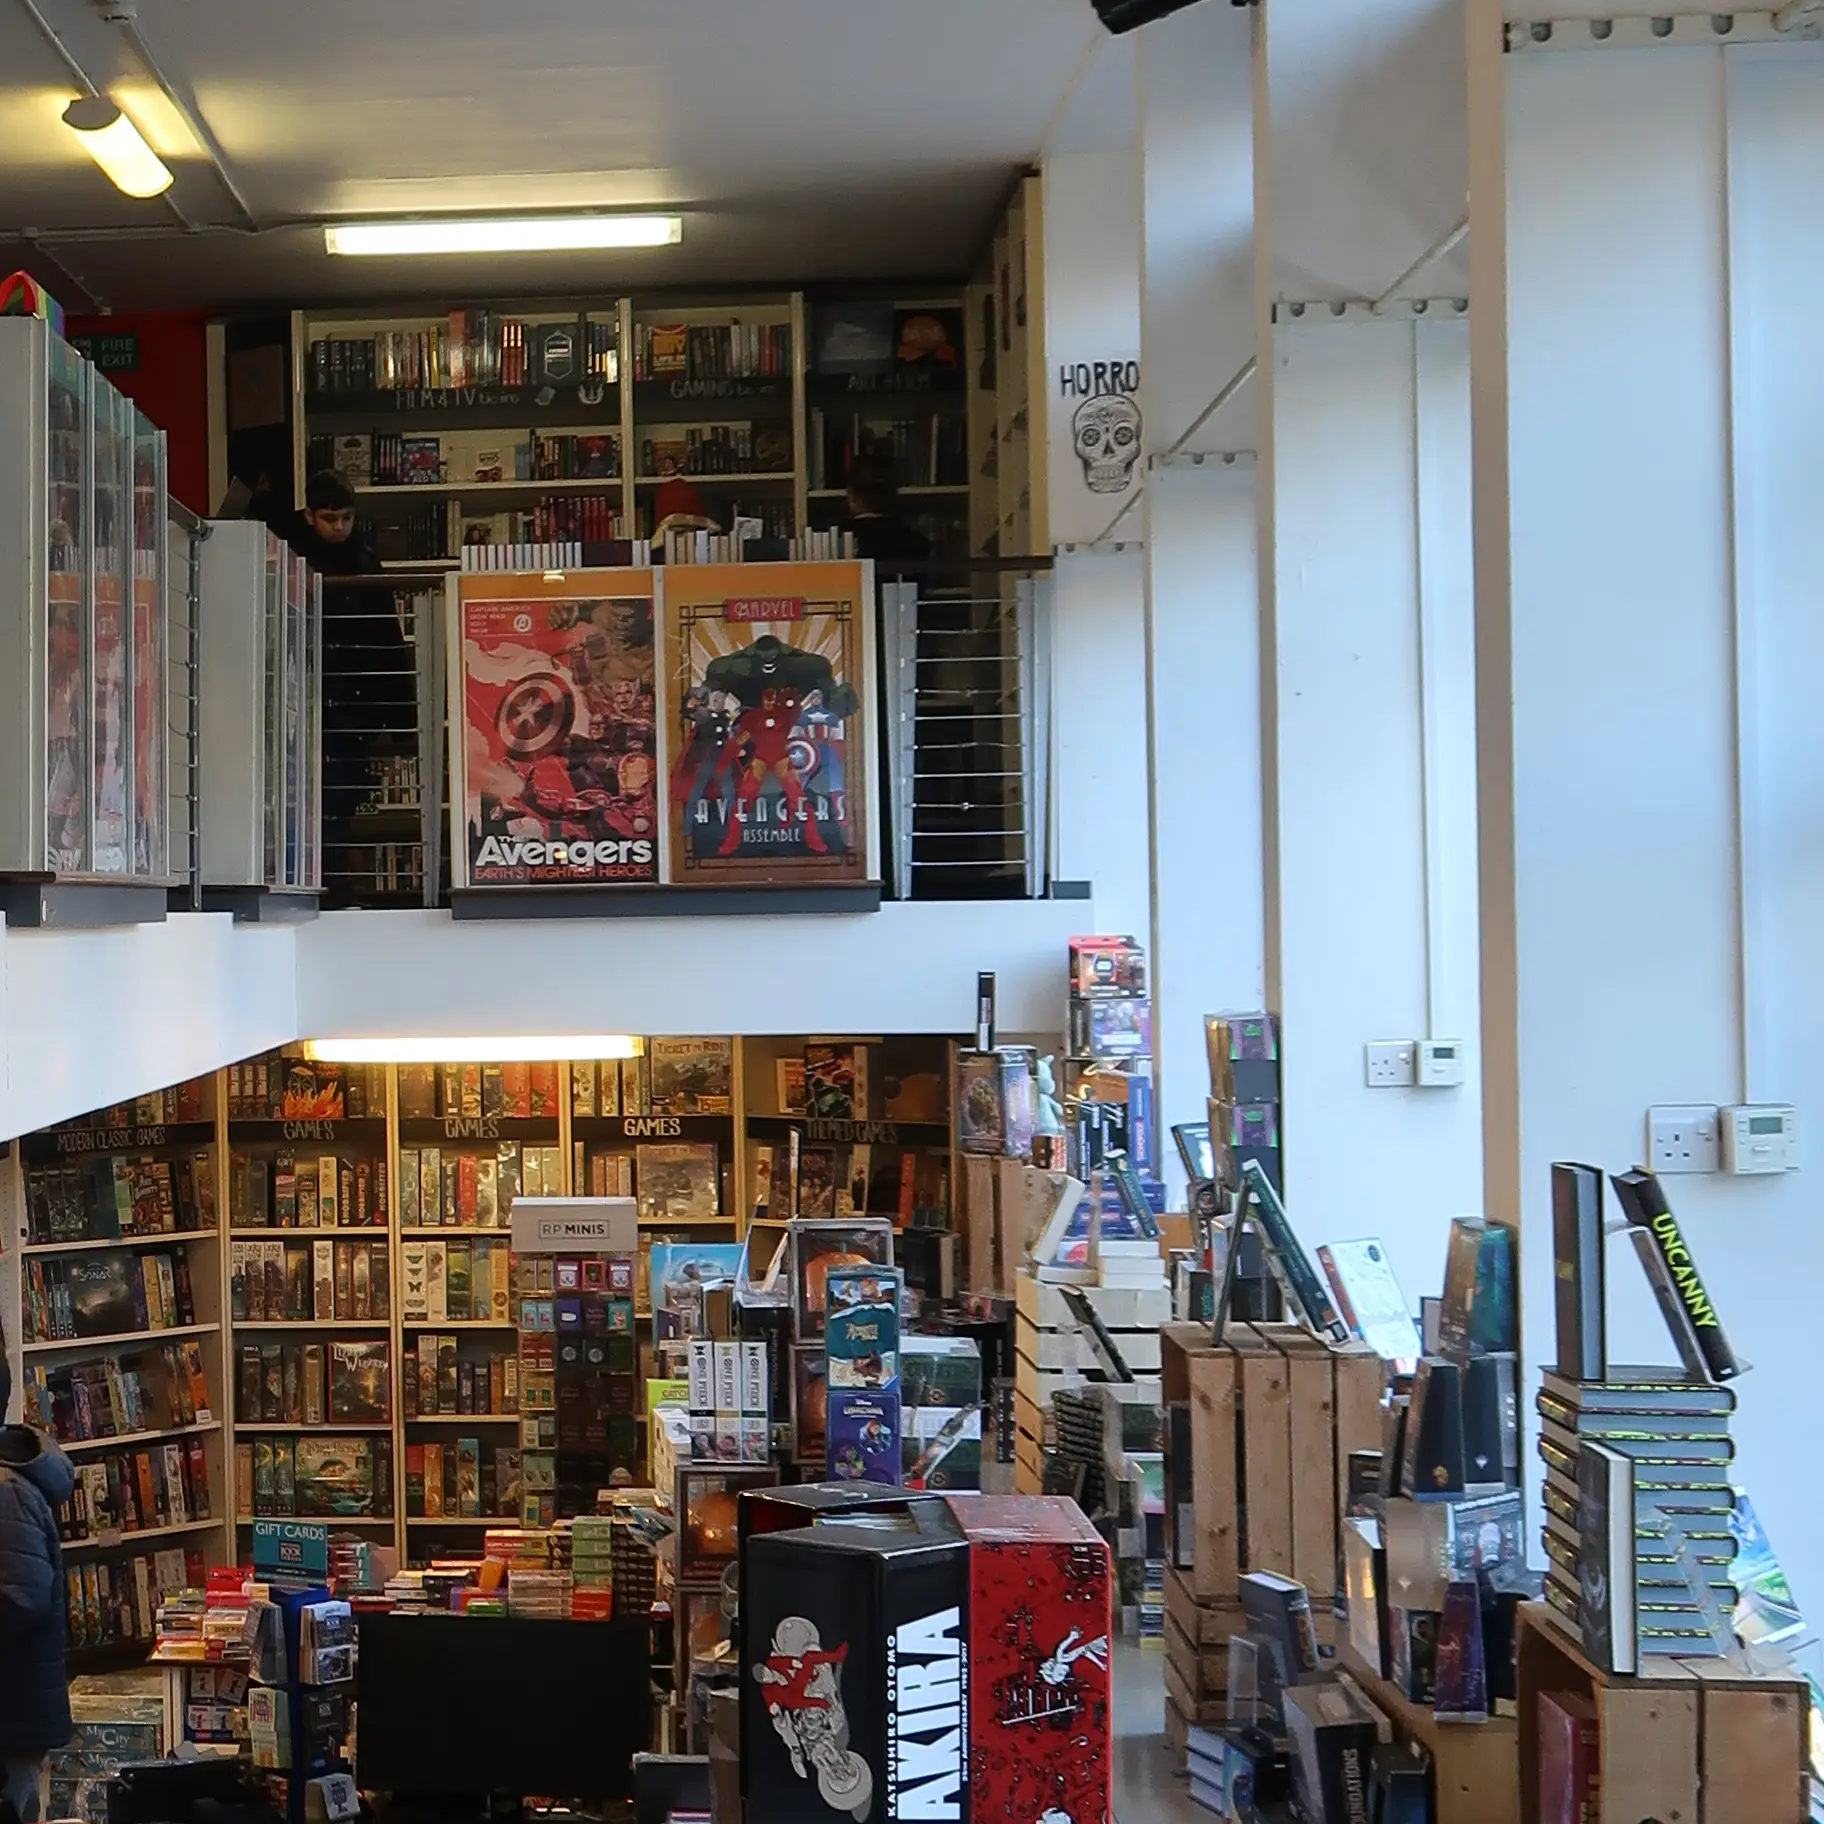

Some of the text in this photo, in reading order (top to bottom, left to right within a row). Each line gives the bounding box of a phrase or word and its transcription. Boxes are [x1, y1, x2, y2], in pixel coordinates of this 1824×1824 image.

[101, 338, 135, 351] FIRE
[102, 353, 134, 366] EXIT
[1059, 360, 1140, 396] HORRO
[396, 391, 432, 410] FILM
[456, 388, 476, 406] TV
[732, 599, 797, 620] MARVEL
[694, 795, 847, 826] AVENGERS
[742, 826, 802, 845] ASSEMBLE
[476, 835, 654, 868] Avengers
[474, 866, 525, 881] EARTH'S
[599, 865, 653, 878] HEROES
[656, 1040, 728, 1054] TICKET RIDE
[283, 1119, 336, 1141] GAMES
[445, 1119, 500, 1139] GAMES
[624, 1117, 682, 1136] GAMES
[57, 1126, 166, 1152] MODERN CLASSIC GAMES
[542, 1223, 605, 1235] RP MINIS
[78, 1264, 112, 1282] SONAR
[1652, 1212, 1718, 1327] UNCANNY
[255, 1523, 325, 1542] GIFT CARDS
[896, 1606, 961, 1821] AKIRA
[887, 1634, 897, 1818] KATSUHIRO OTOMO
